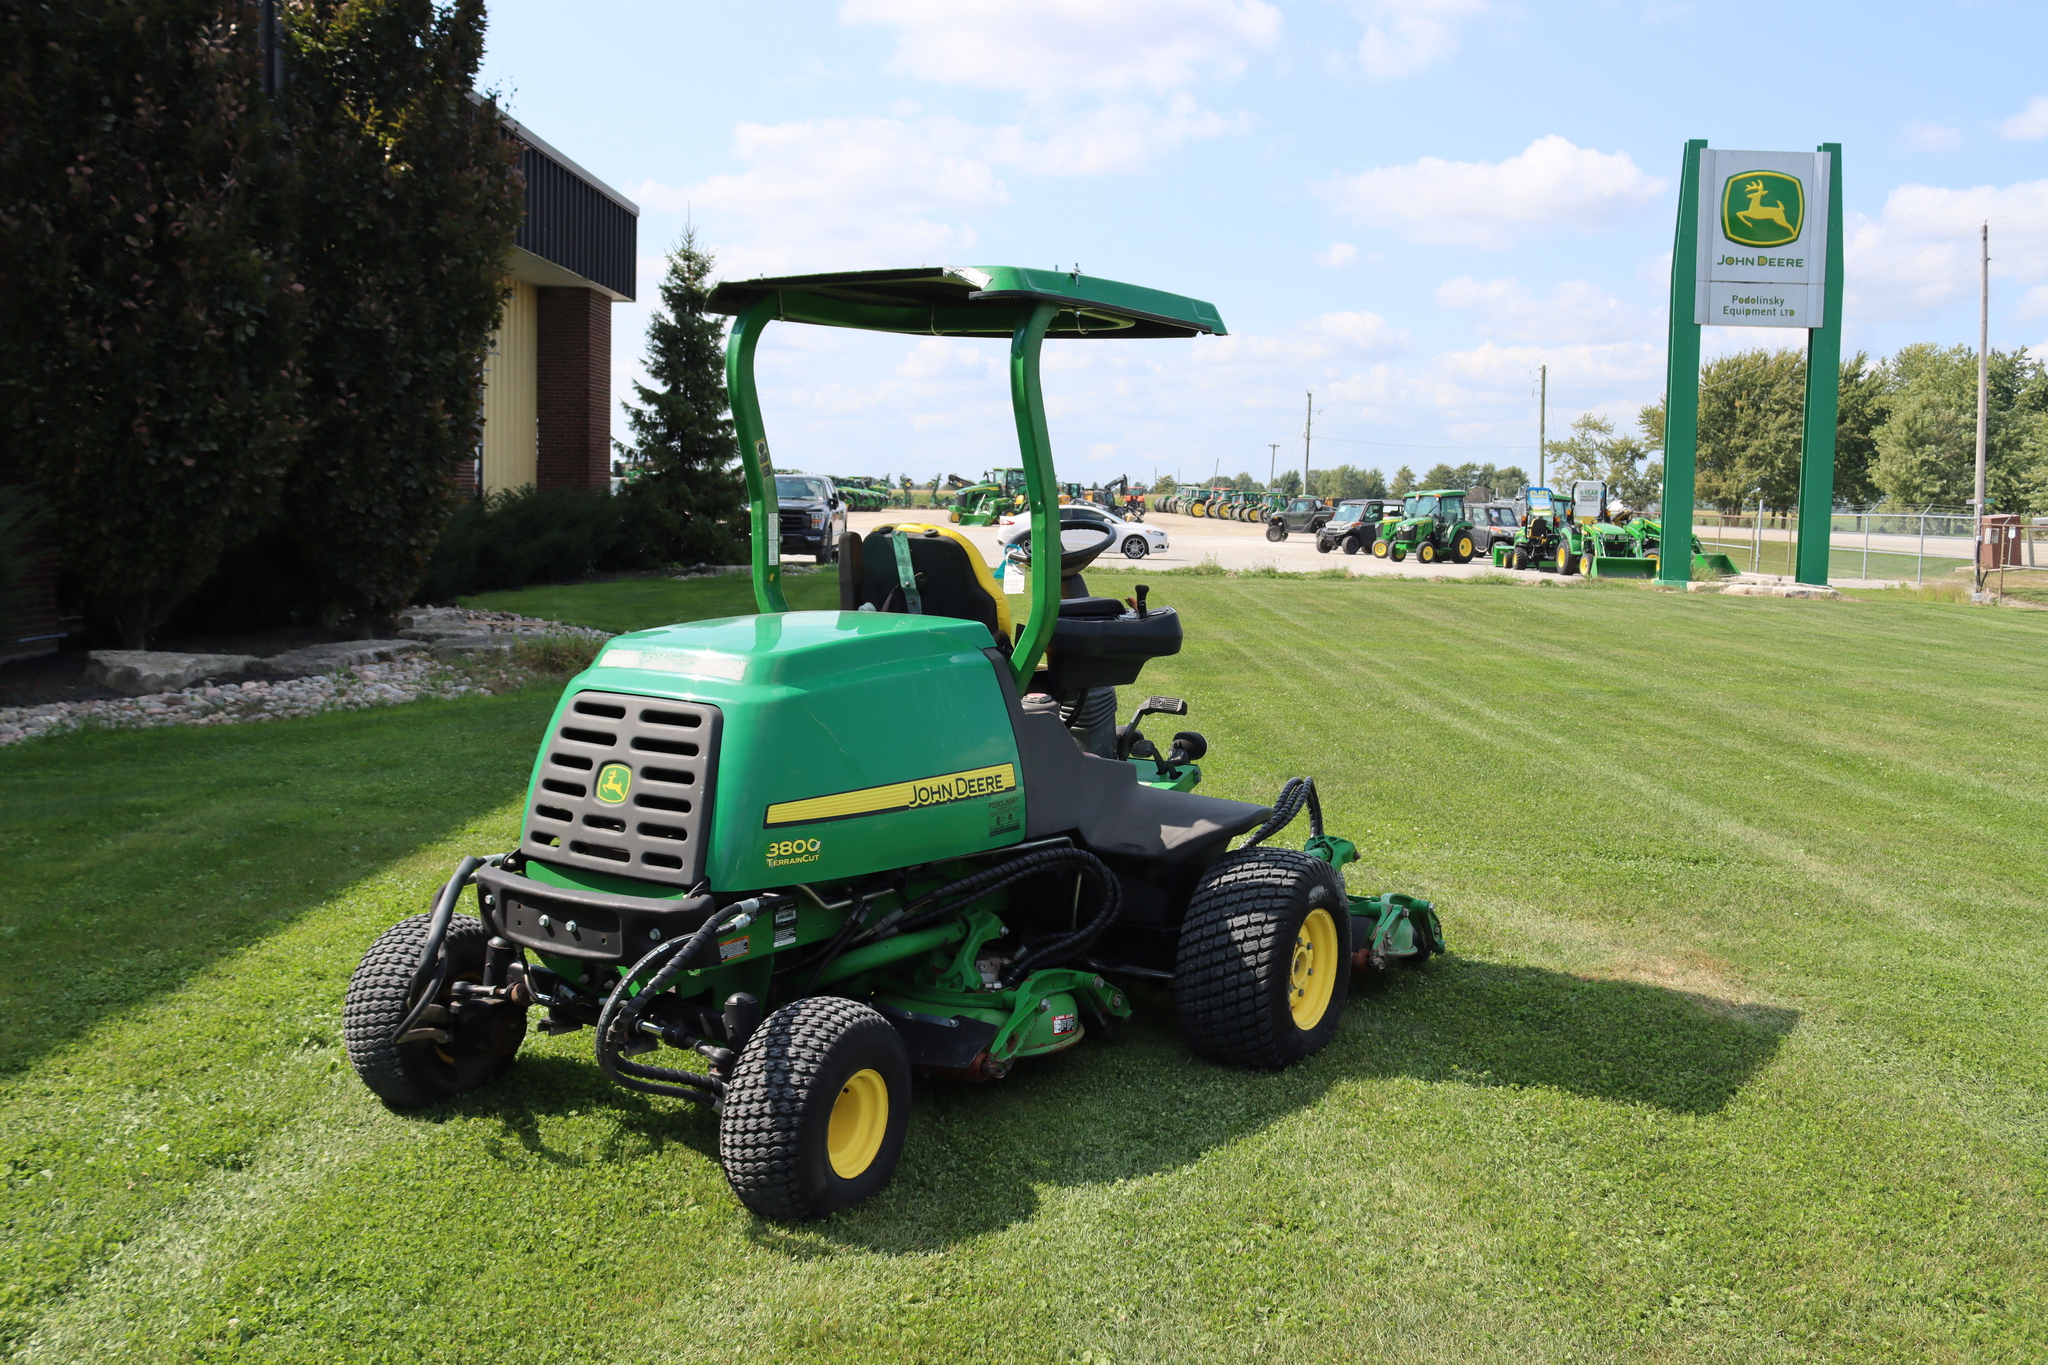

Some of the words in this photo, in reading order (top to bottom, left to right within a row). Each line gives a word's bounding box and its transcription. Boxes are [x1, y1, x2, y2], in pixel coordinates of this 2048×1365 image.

[1717, 254, 1755, 266] JOHN
[1757, 255, 1804, 268] DEERE
[1732, 294, 1785, 307] Podolinsky
[1723, 305, 1777, 317] Equipment
[1780, 309, 1795, 317] LTD
[909, 782, 953, 806] JOHN
[955, 774, 1004, 796] DEERE
[988, 797, 1019, 809] PODOLINSKY
[765, 837, 821, 858] 3800
